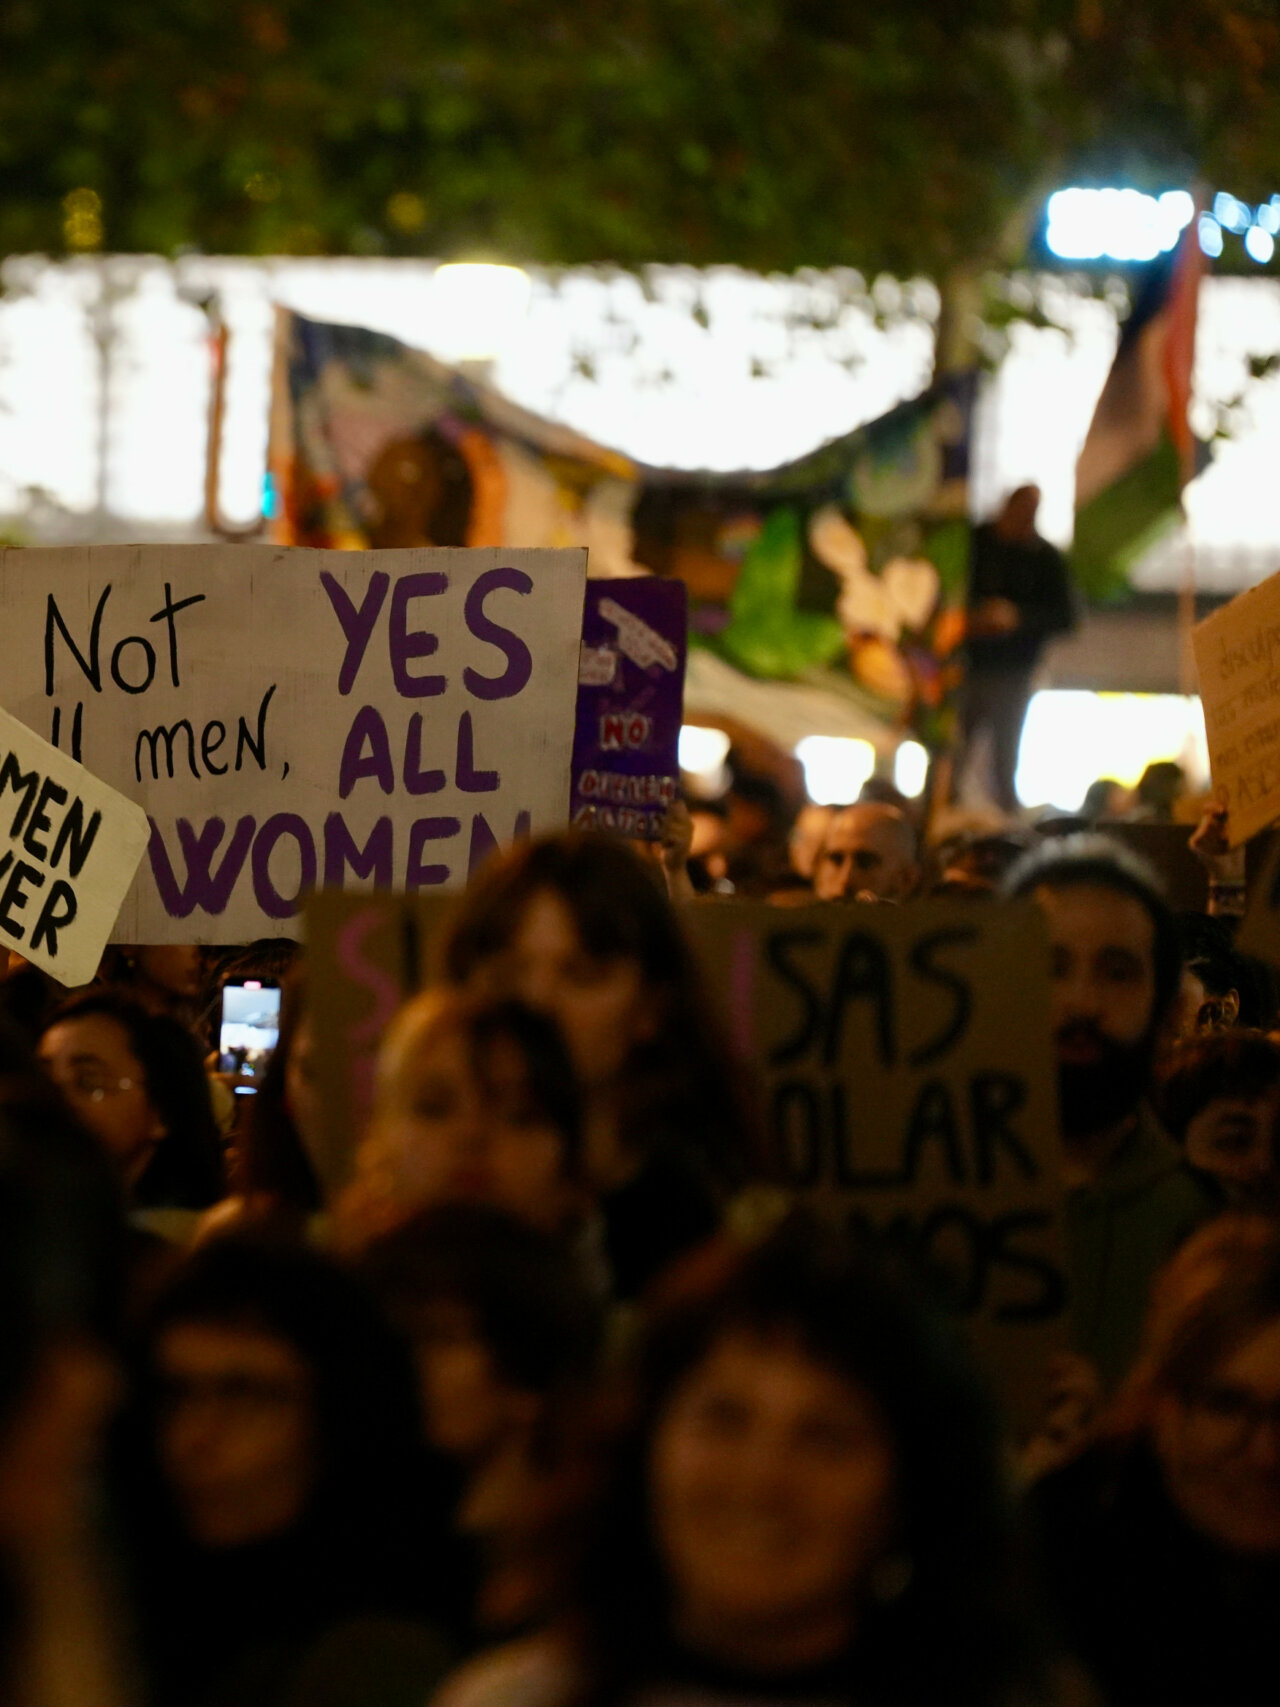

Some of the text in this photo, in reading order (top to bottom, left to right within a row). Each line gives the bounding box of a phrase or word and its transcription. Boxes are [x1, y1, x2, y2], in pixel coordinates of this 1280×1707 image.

[45, 582, 206, 696] Not
[321, 567, 535, 700] YES
[51, 701, 84, 765] ll
[338, 705, 500, 799] ALL
[598, 711, 649, 751] NO
